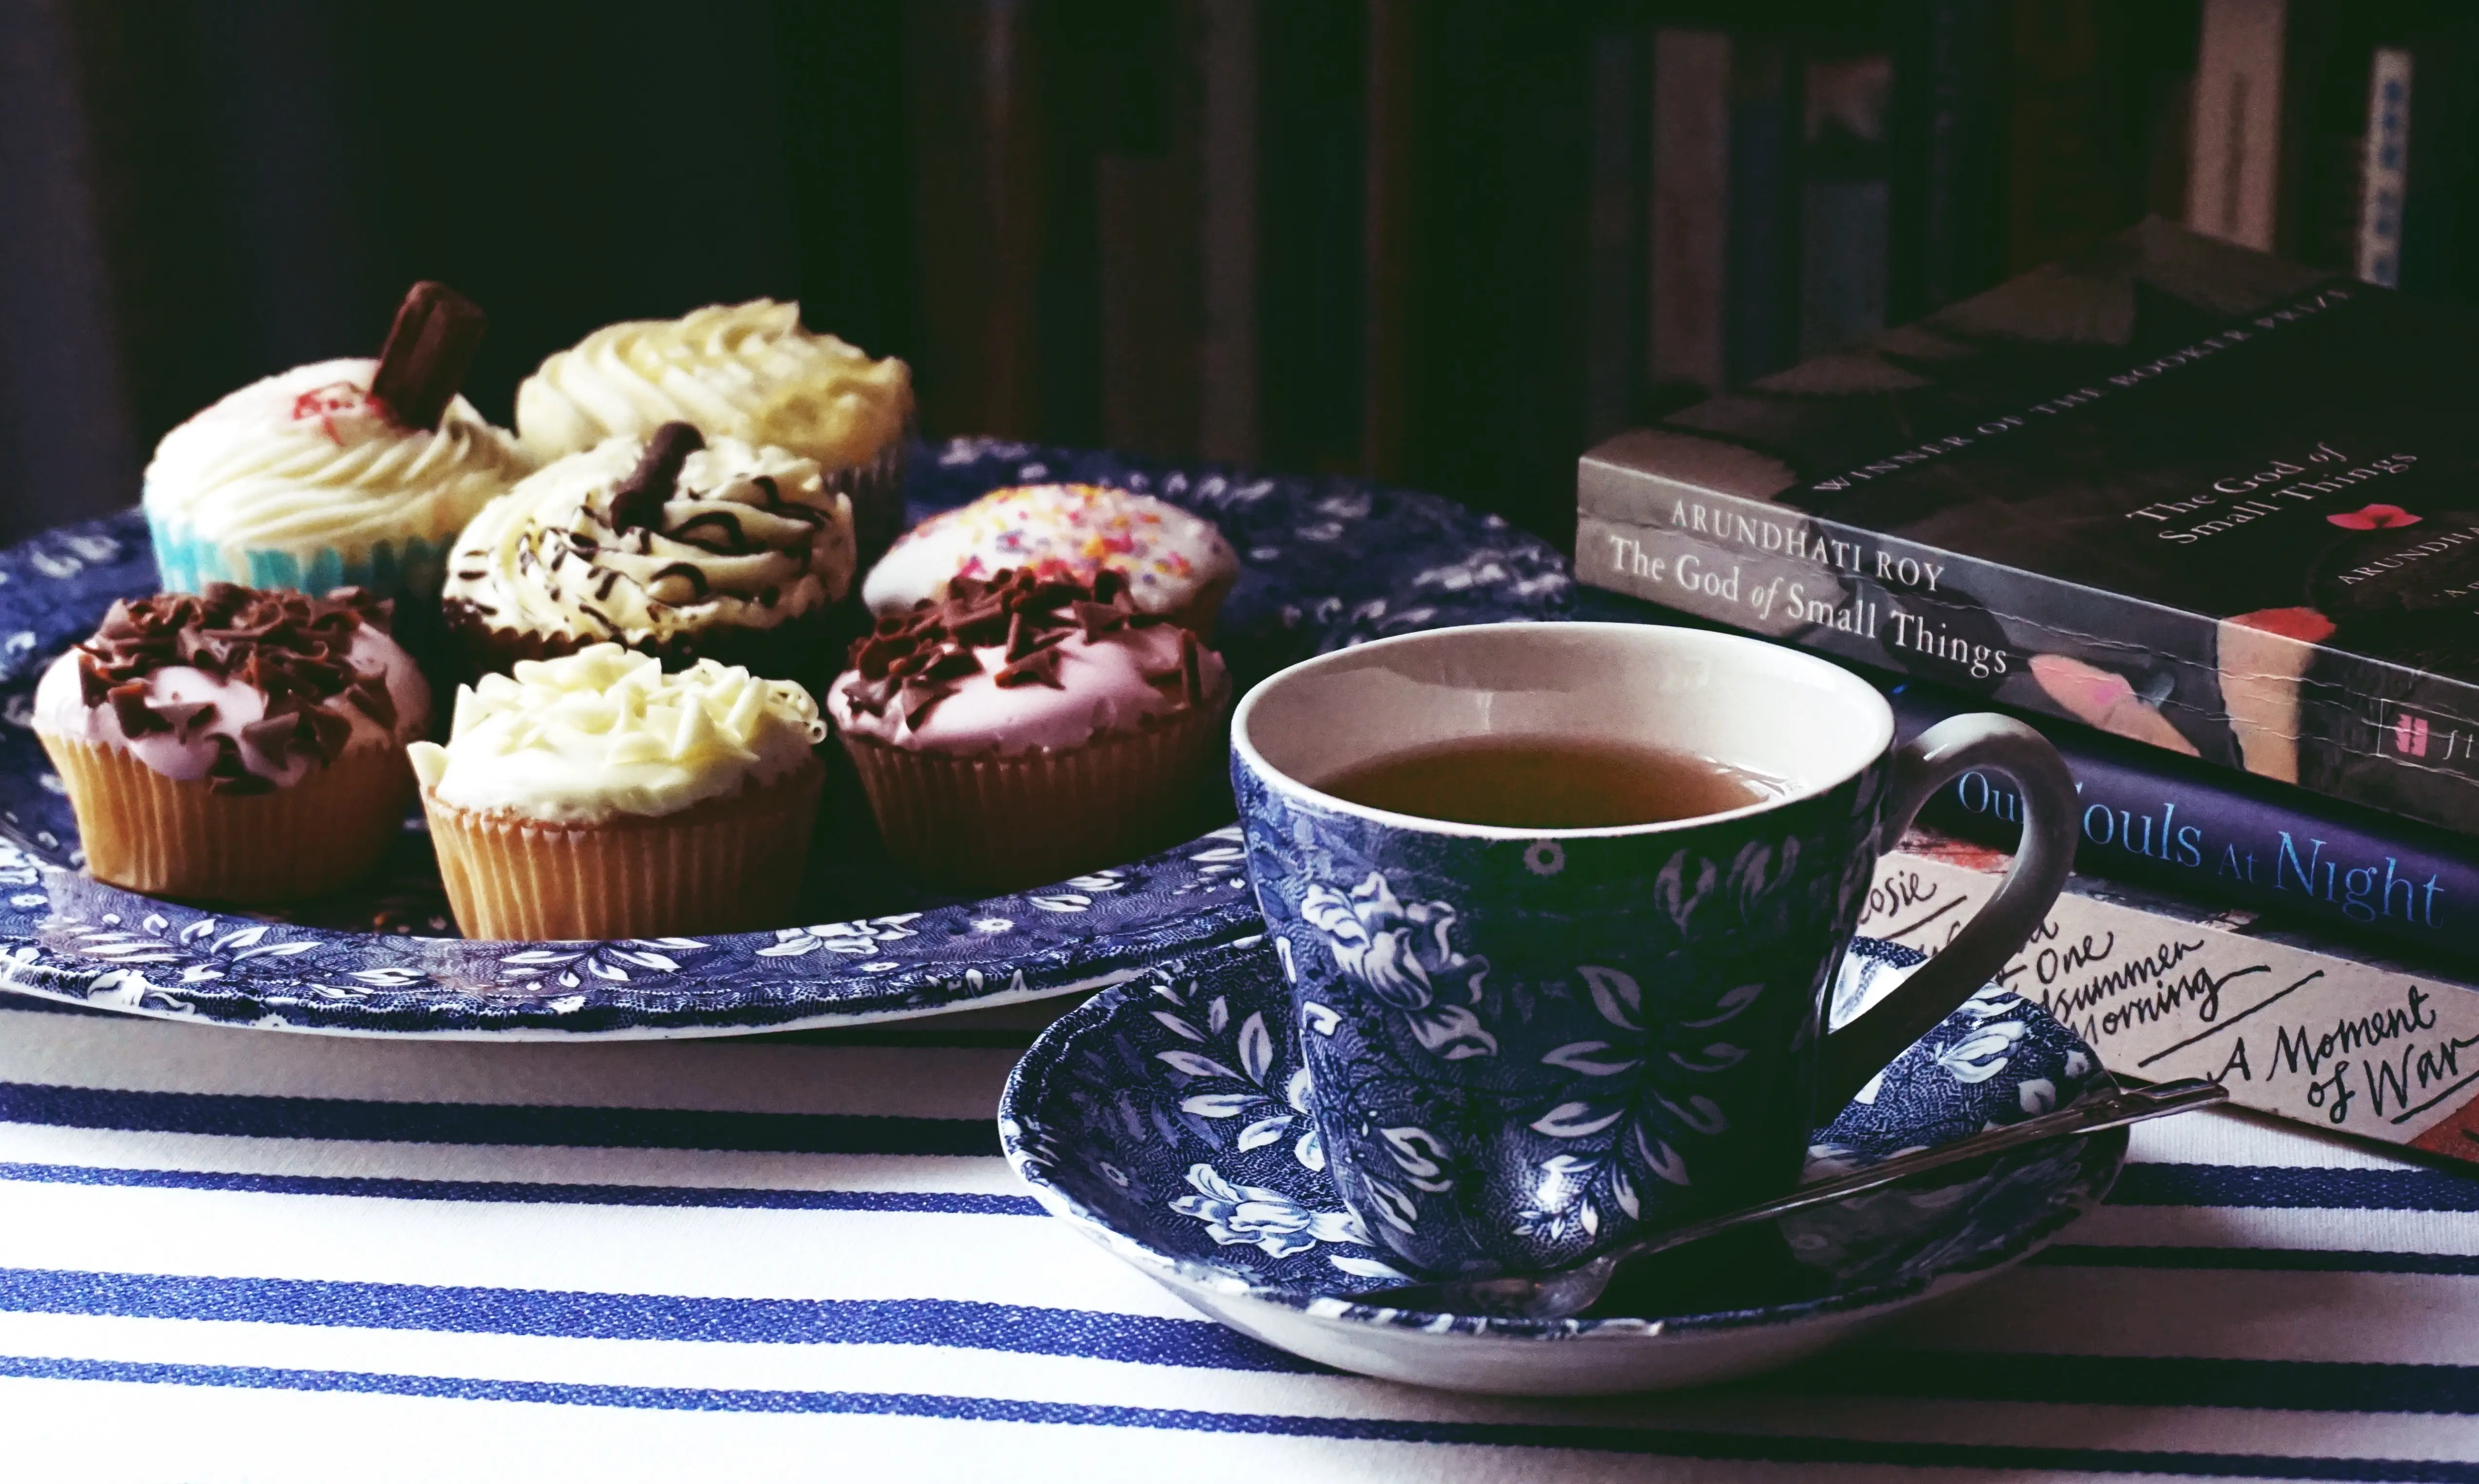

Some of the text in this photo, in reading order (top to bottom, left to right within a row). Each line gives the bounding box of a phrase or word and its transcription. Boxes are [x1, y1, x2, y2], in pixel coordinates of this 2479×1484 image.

[1811, 436, 1974, 490] WINNER
[1977, 414, 2025, 434] OF
[2028, 388, 2109, 414] THE
[2107, 329, 2253, 387] BOOKER
[2124, 441, 2347, 522] The God of
[2158, 453, 2418, 544] Small Things
[1671, 499, 1944, 592] ARUNDHATI ROY
[1610, 535, 2008, 678] The God of Small Things
[1958, 771, 2445, 929] Ou ouls At Night
[1859, 870, 1937, 924] osie
[2036, 931, 2114, 984] One
[2207, 985, 2437, 1085] A Moment
[2307, 1034, 2479, 1124] of War
